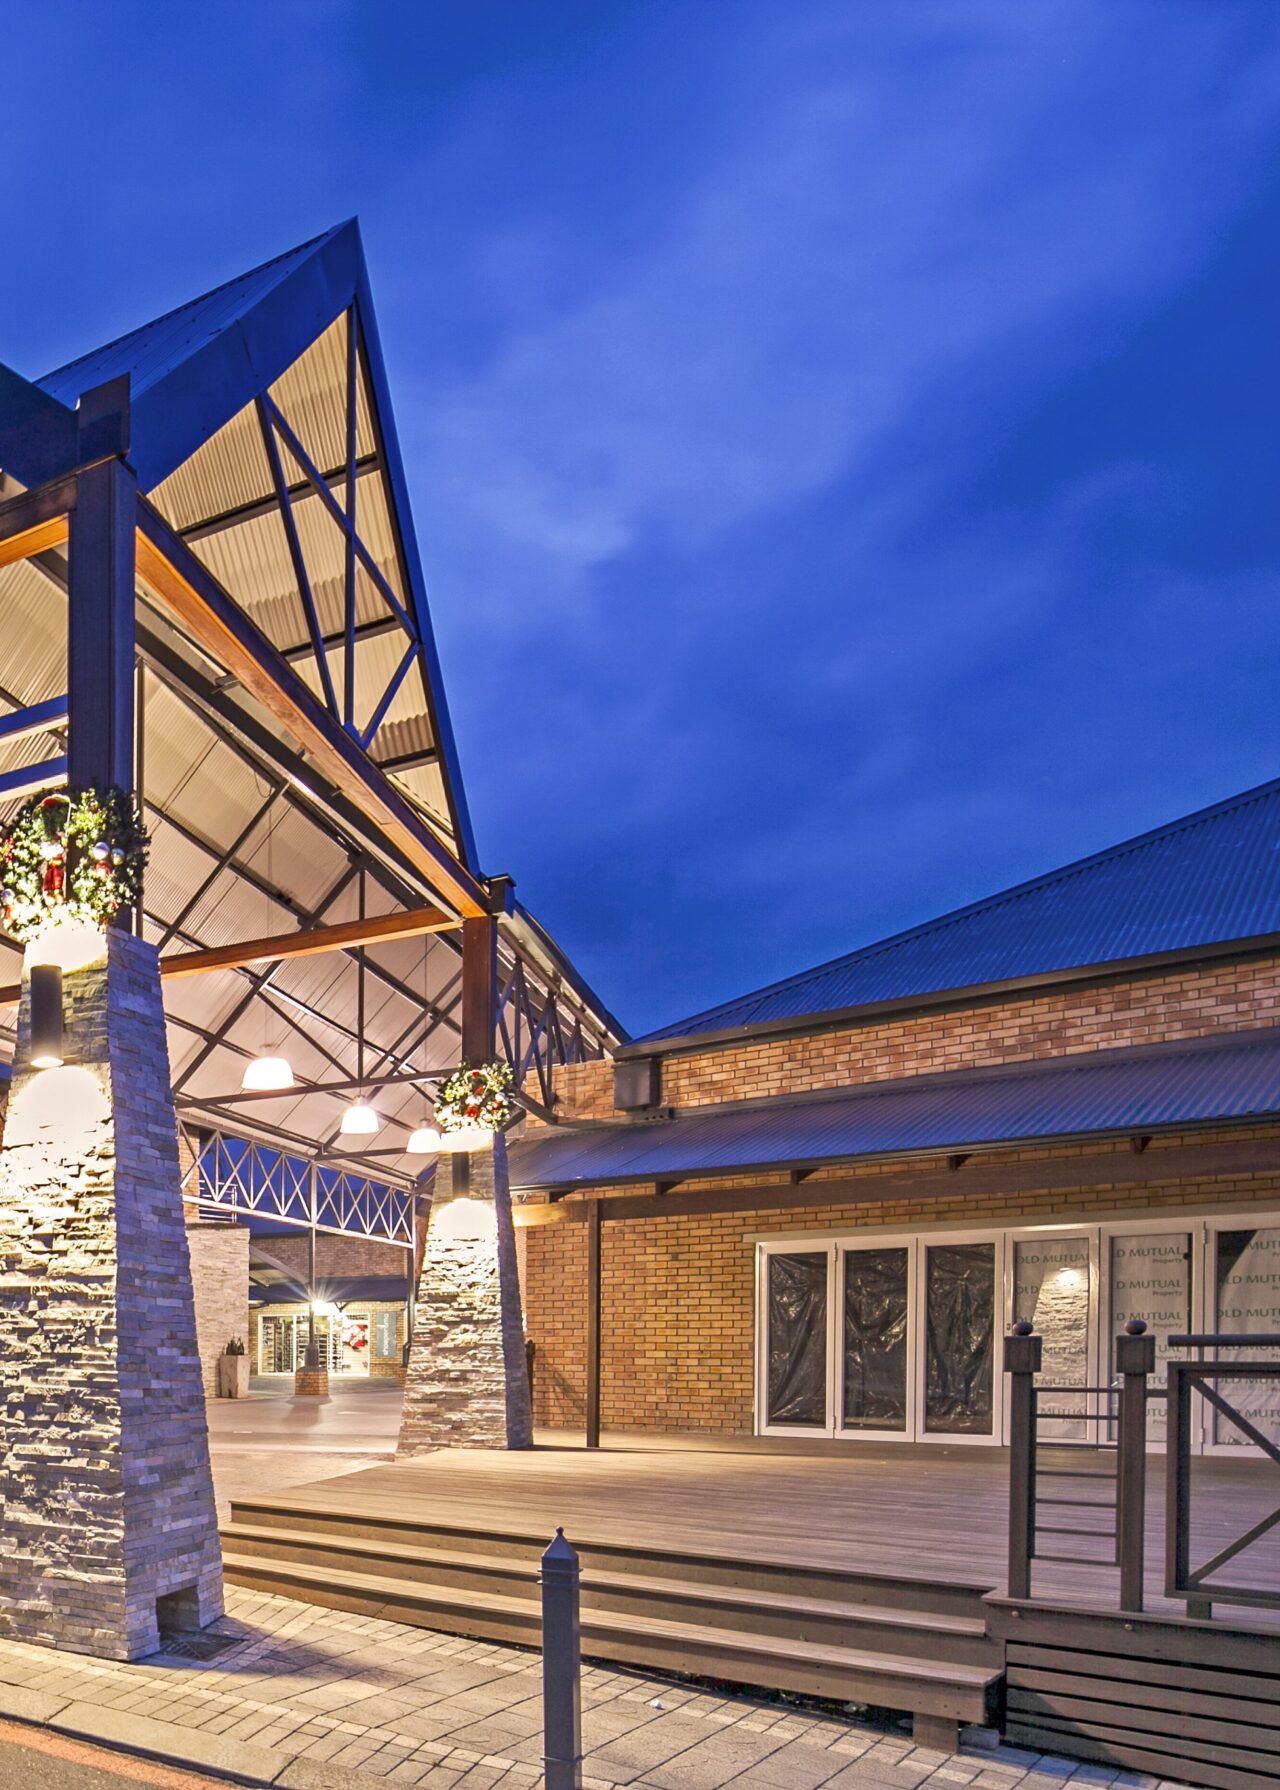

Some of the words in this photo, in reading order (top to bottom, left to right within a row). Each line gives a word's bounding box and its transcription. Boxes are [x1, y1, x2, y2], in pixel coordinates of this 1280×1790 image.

[1129, 1247, 1184, 1257] MUTUAL
[1016, 1255, 1040, 1265] OLD
[1129, 1280, 1183, 1289] MUTUAL
[1129, 1312, 1183, 1321] MUTUAL
